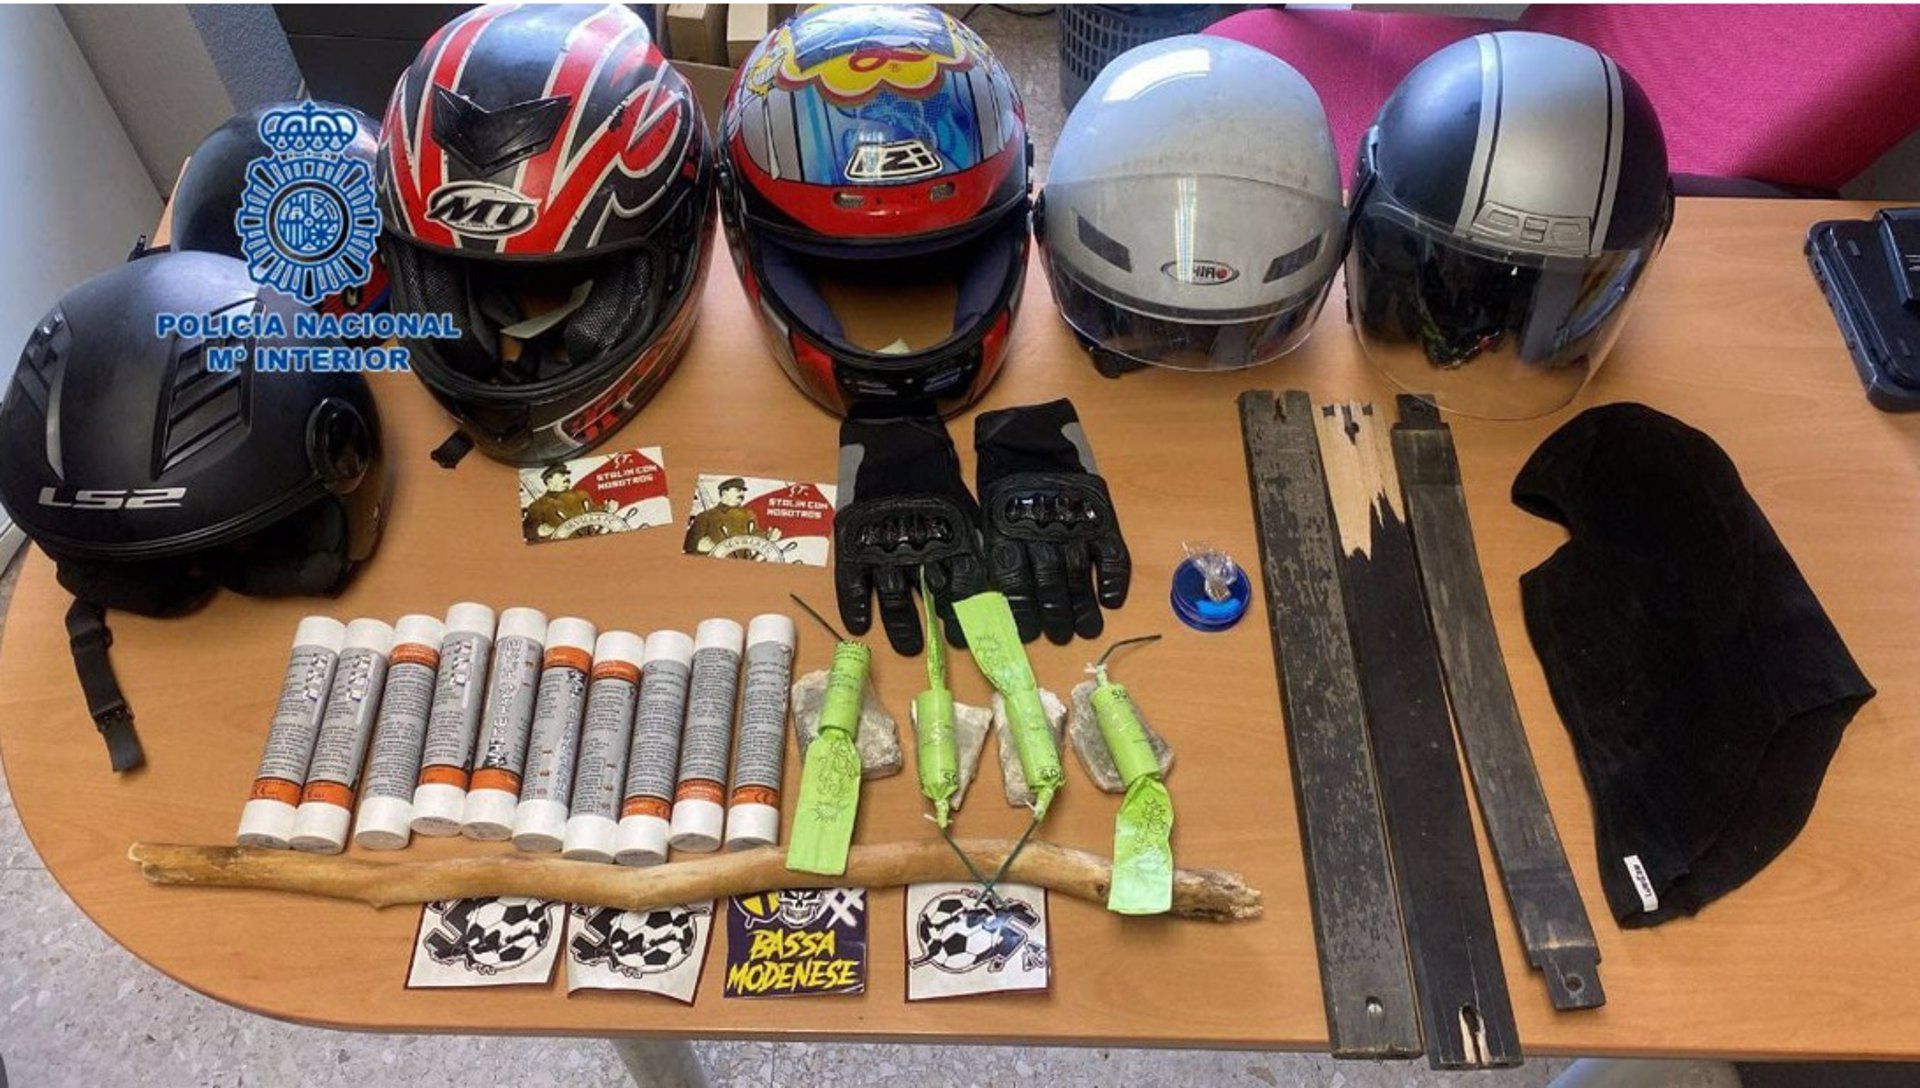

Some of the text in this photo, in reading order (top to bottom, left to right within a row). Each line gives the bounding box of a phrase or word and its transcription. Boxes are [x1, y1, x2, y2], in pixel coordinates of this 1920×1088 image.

[427, 195, 537, 226] MT
[38, 486, 188, 509] LS2
[748, 928, 836, 960] BASSA
[727, 959, 860, 994] MODENESE
